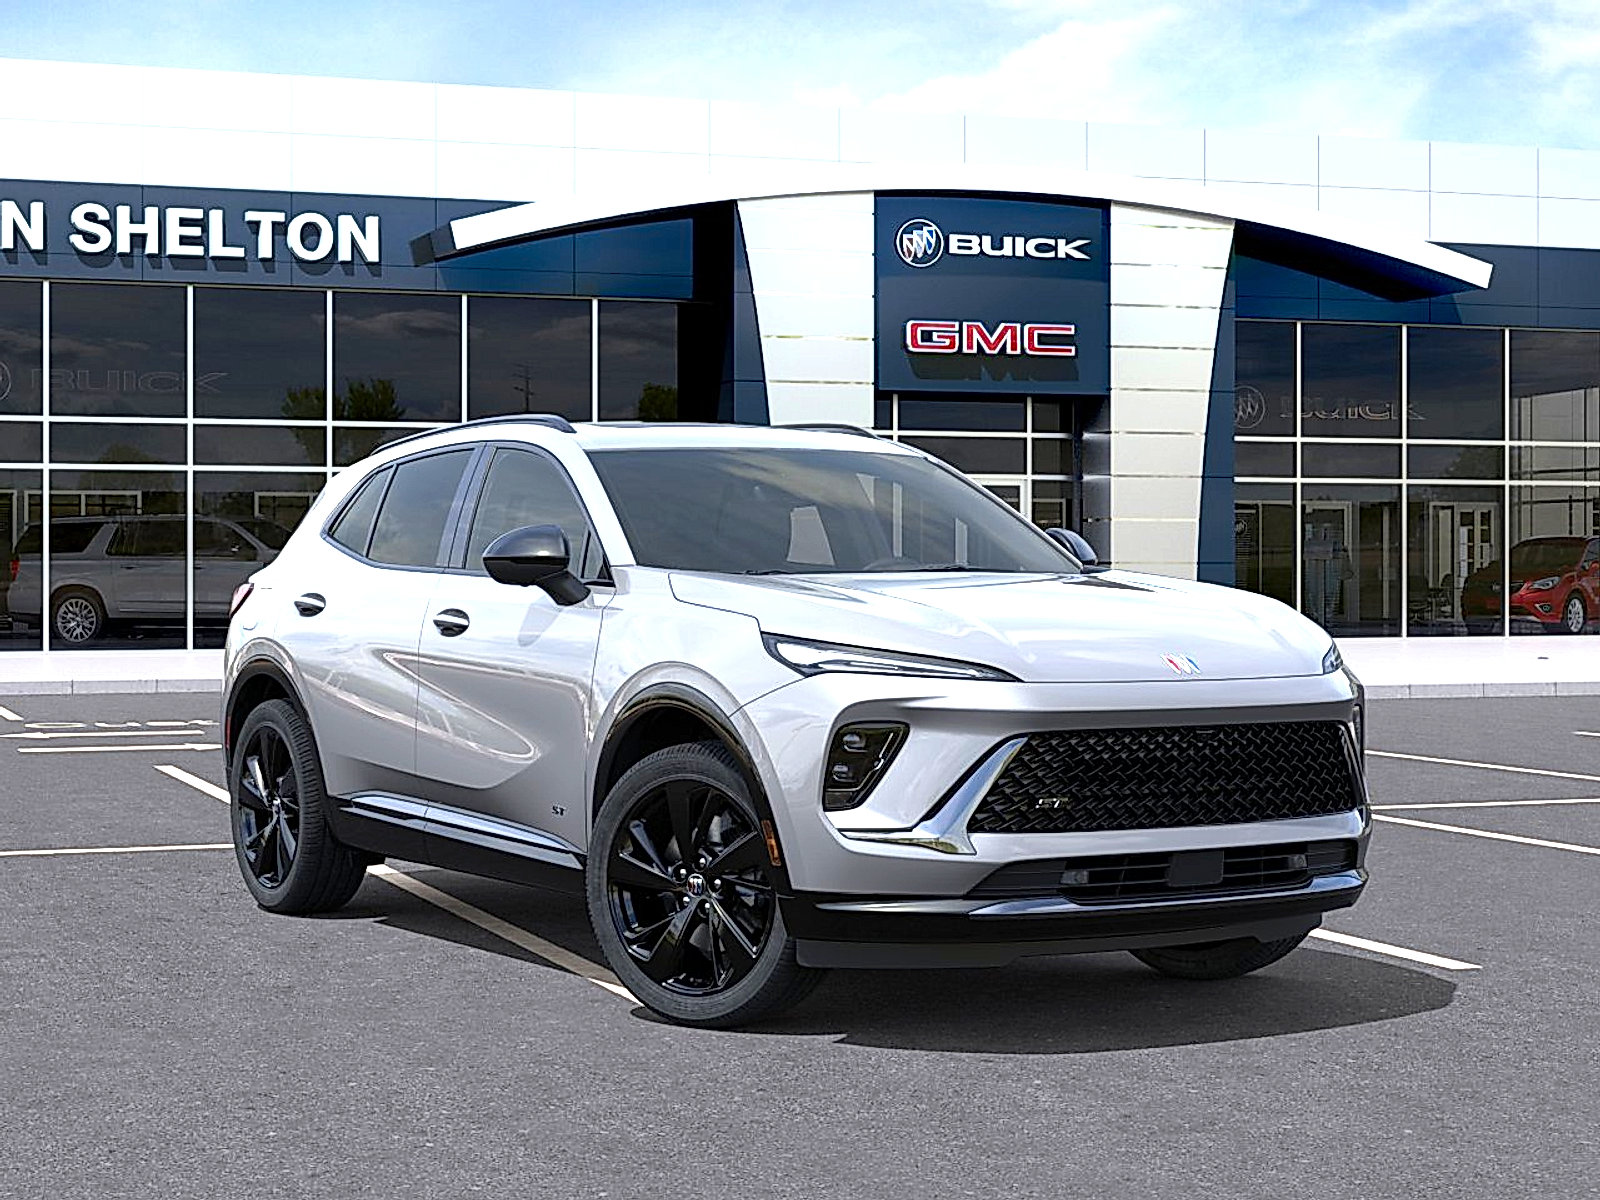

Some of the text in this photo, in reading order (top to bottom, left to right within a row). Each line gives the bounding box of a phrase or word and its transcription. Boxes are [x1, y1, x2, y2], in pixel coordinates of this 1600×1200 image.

[0, 200, 380, 263] N SHELTON
[949, 233, 1092, 260] BUICK
[906, 319, 1076, 356] GMC
